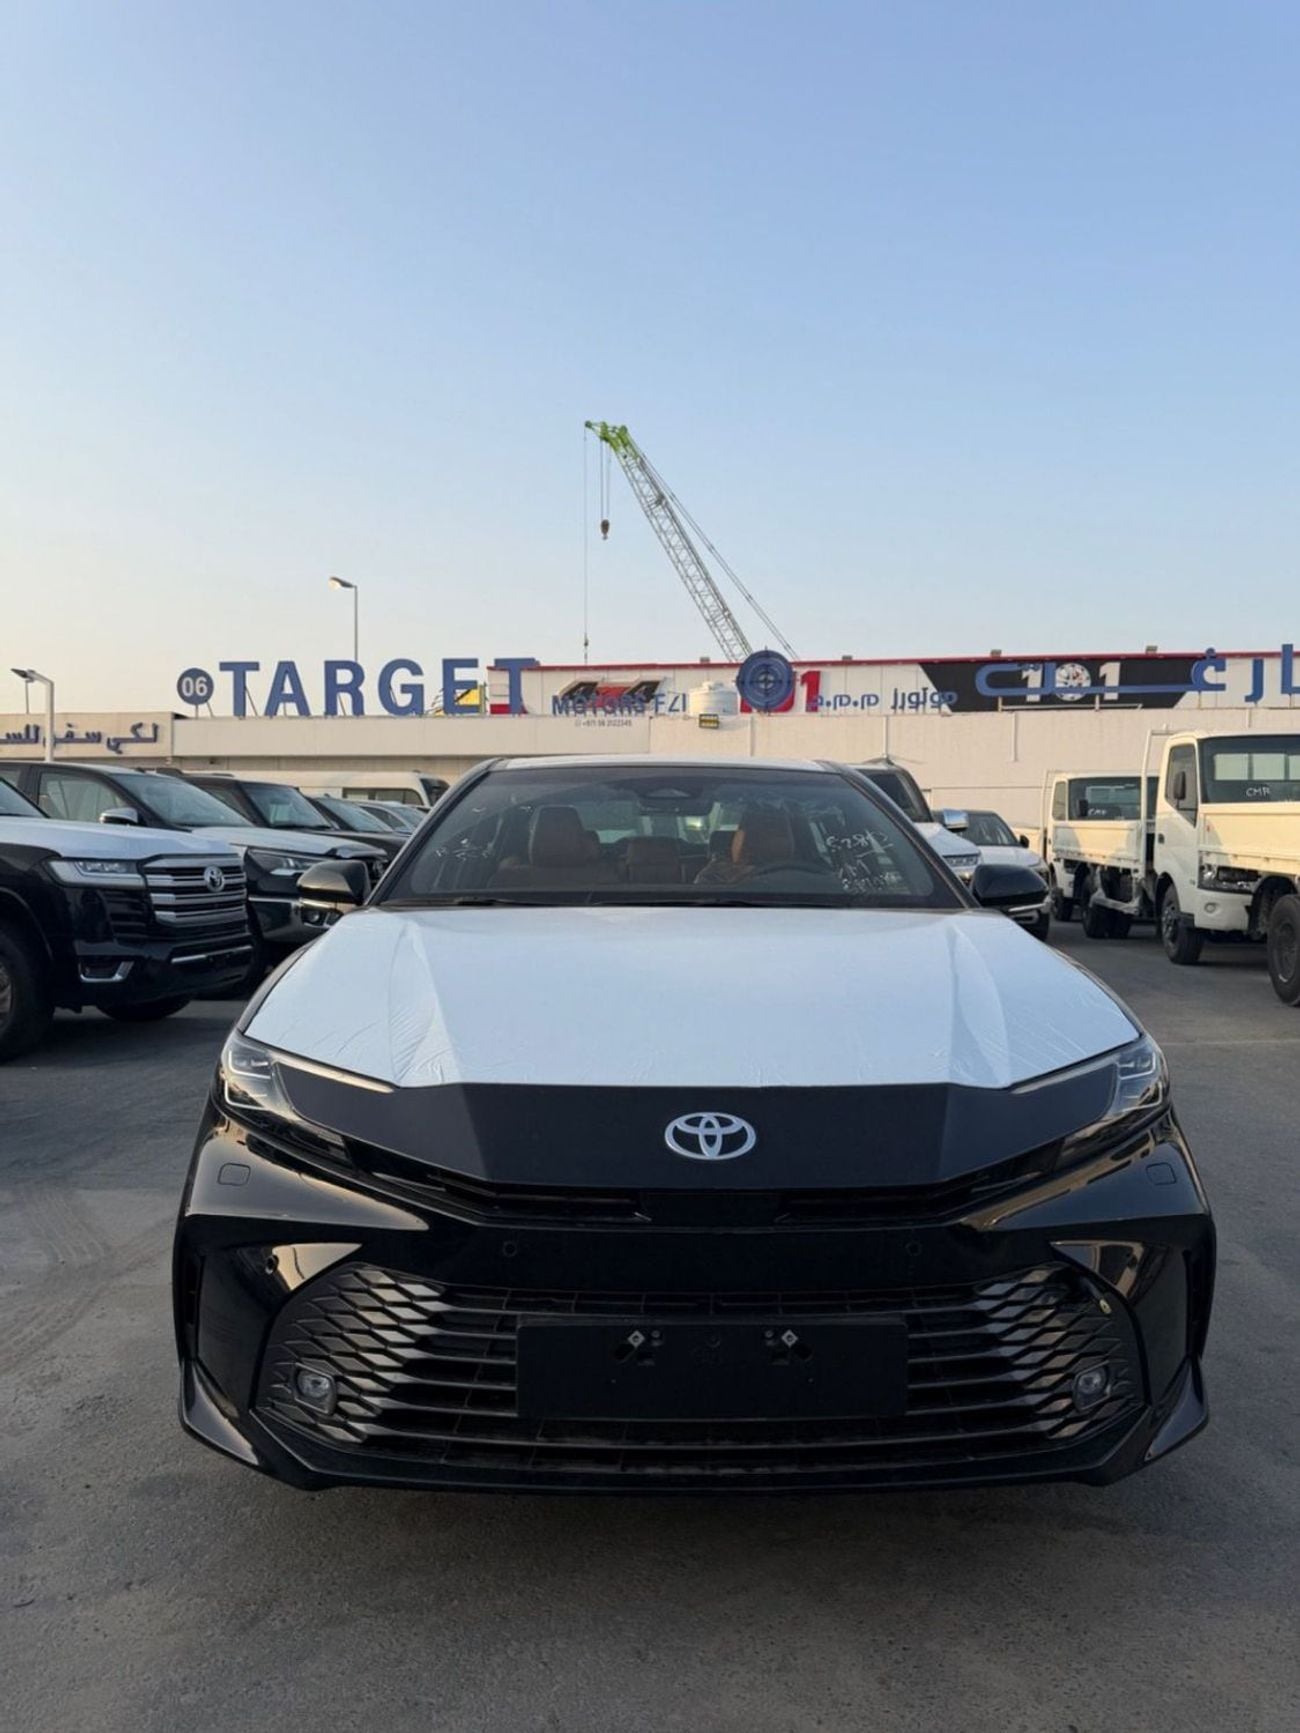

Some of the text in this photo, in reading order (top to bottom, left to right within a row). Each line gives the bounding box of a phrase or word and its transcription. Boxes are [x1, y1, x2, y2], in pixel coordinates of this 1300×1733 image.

[181, 676, 208, 698] 06
[219, 657, 541, 717] TARGET
[552, 694, 646, 716] MOTORS
